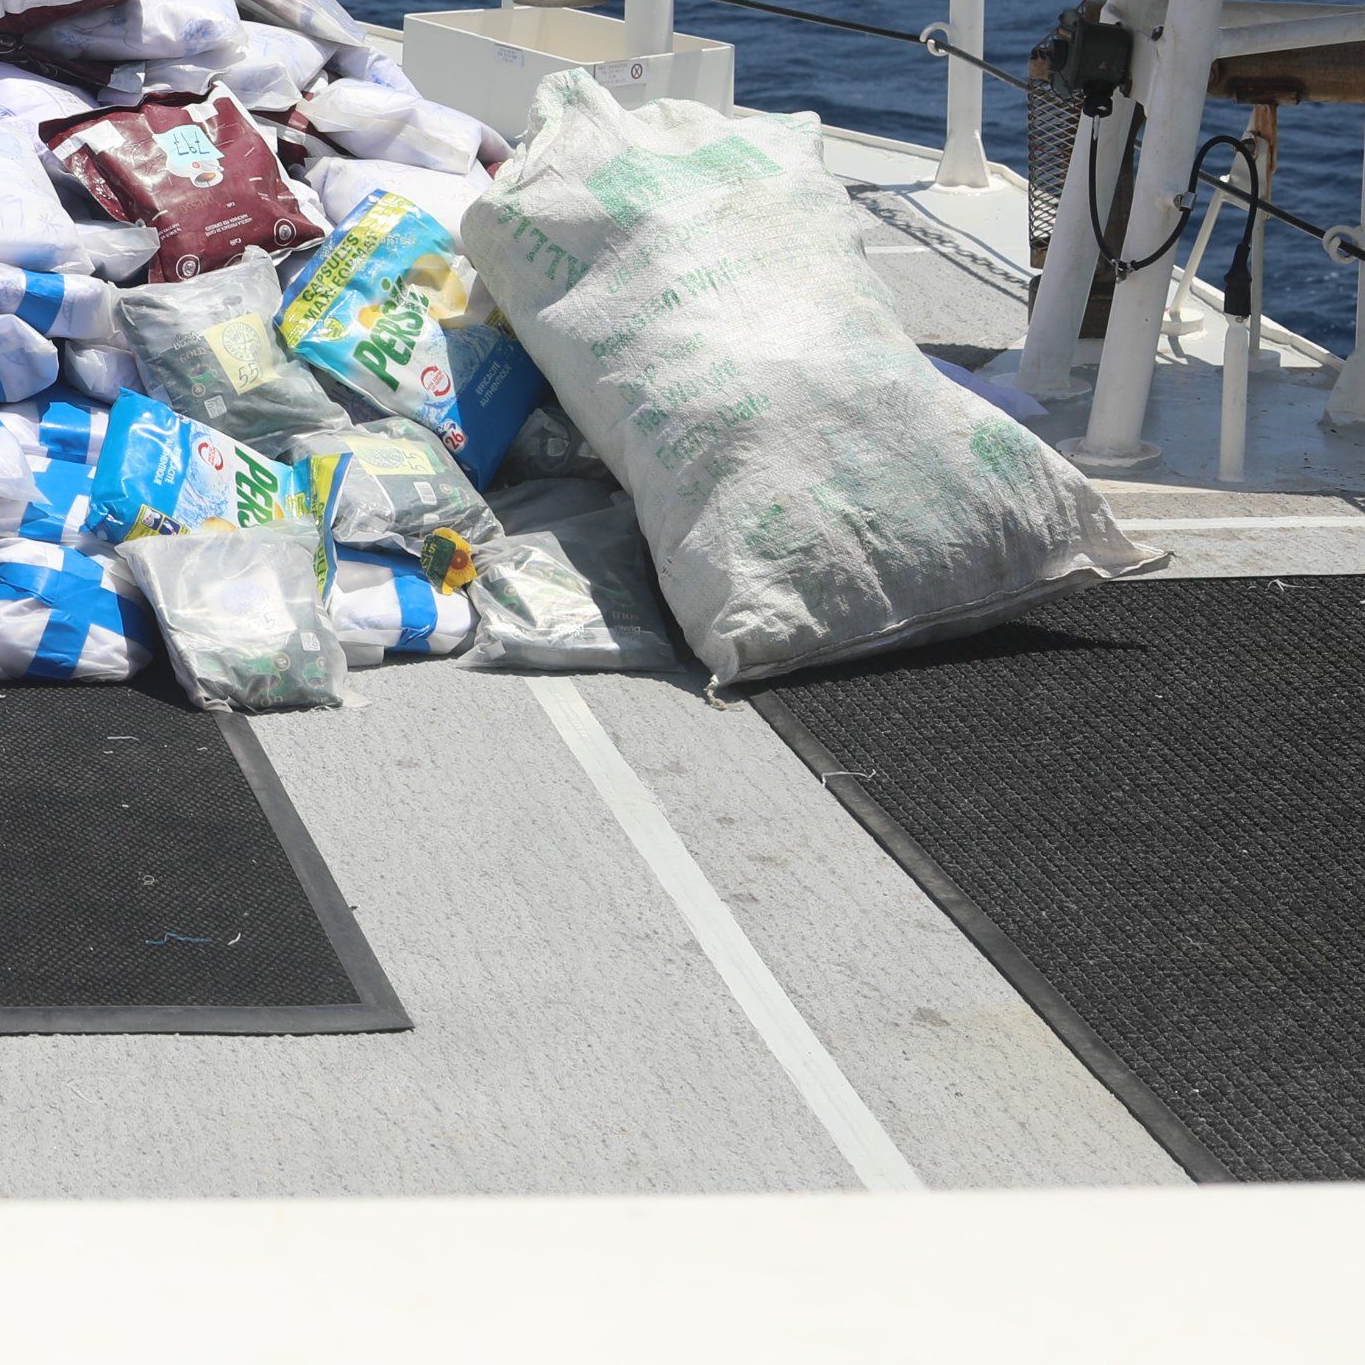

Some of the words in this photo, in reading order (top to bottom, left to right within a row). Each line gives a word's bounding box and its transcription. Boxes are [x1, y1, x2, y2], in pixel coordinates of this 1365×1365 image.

[302, 234, 360, 303] CAPSULES
[237, 362, 260, 387] 55
[475, 361, 501, 396] EFFICACITÉ
[479, 364, 513, 408] AUTHENTIQUE
[444, 432, 465, 451] 26
